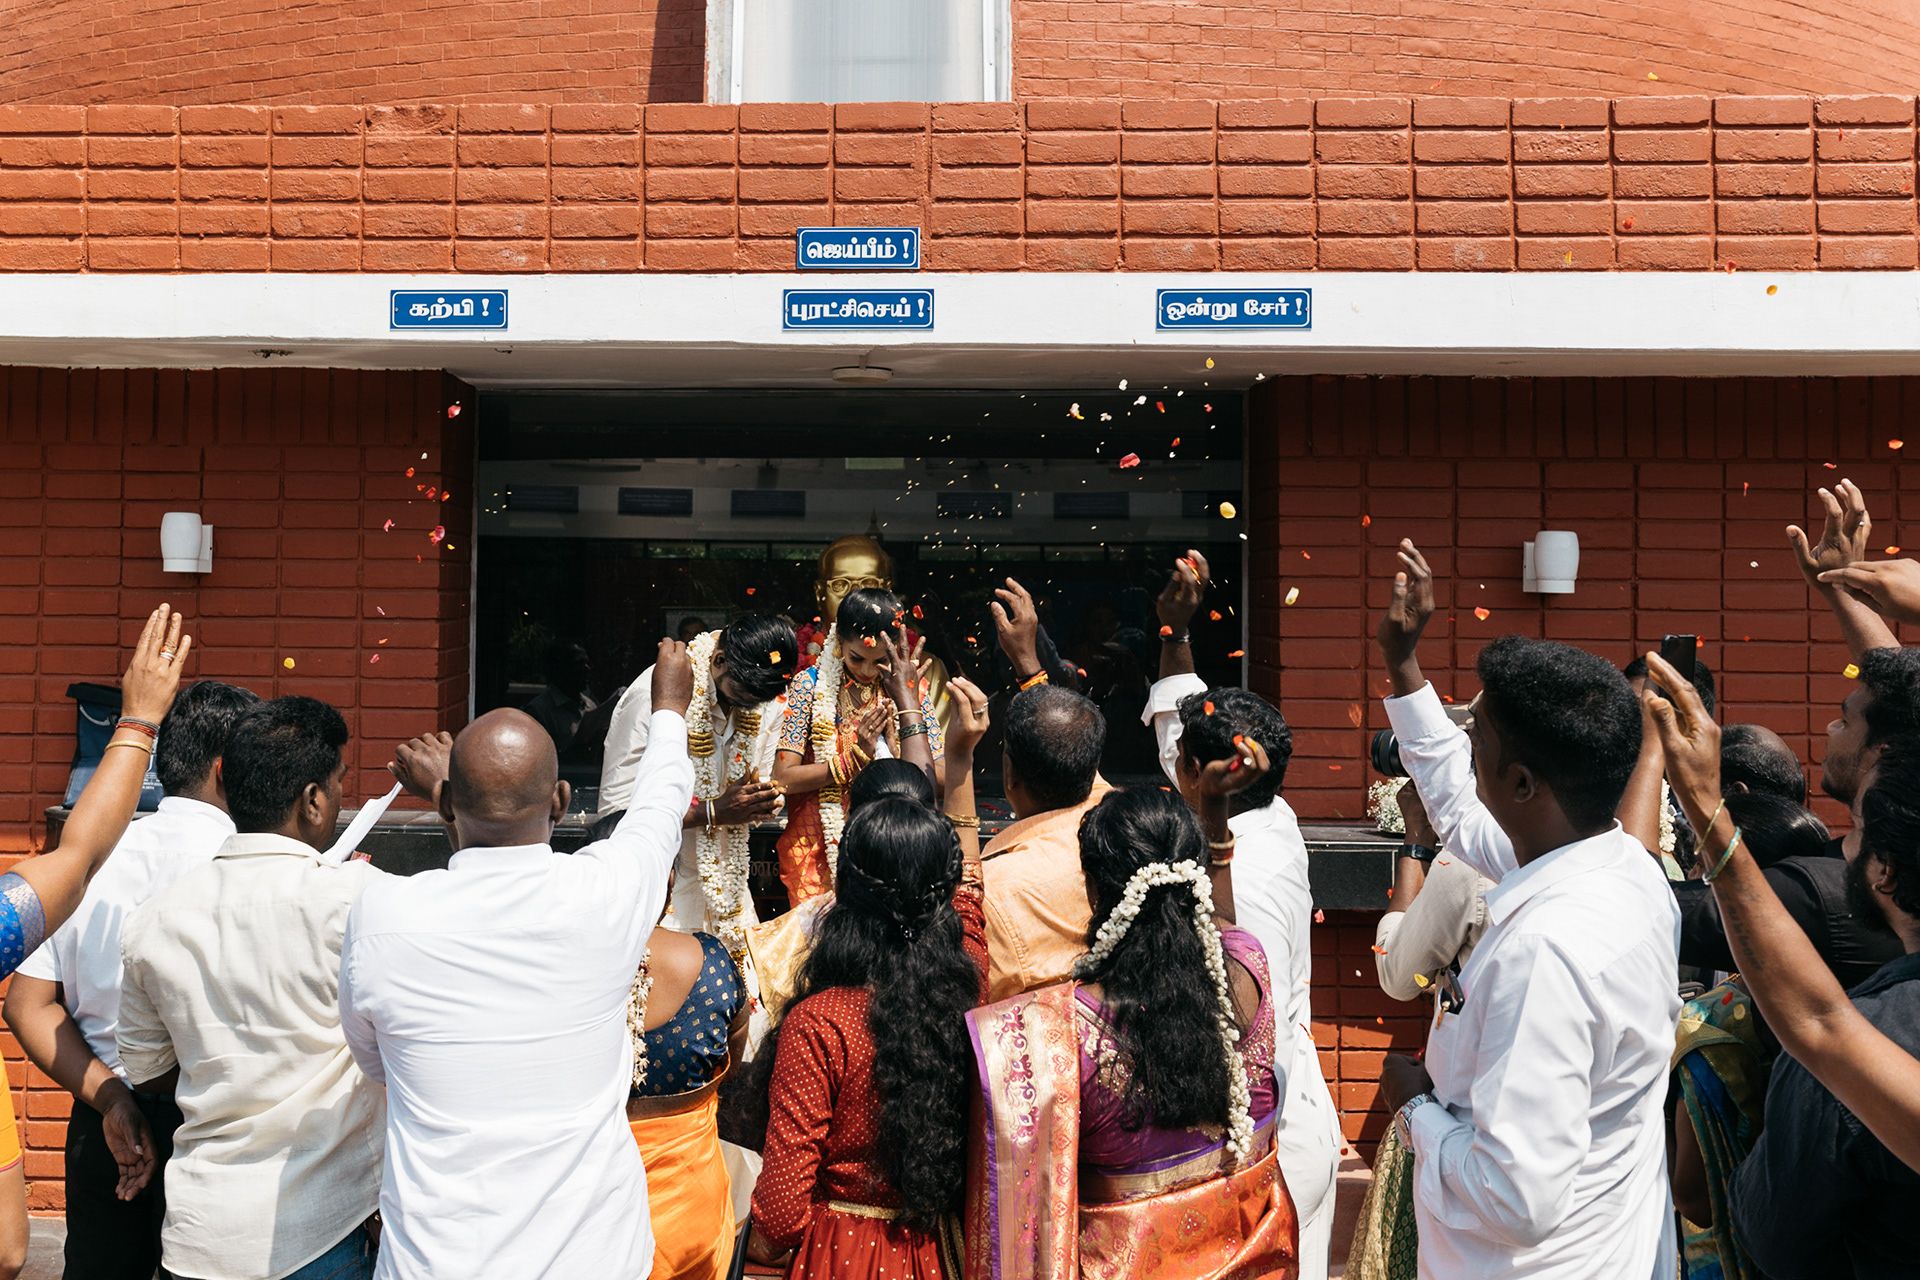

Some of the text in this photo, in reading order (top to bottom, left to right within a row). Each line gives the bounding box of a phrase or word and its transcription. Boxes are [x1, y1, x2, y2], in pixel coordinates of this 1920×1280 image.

[806, 237, 897, 259] ஜெய்பீம்
[408, 297, 474, 321] கற்பி
[791, 297, 911, 321] புரட்சிசெய்
[1166, 297, 1237, 321] ஒன்று
[1244, 297, 1290, 316] சேர்
